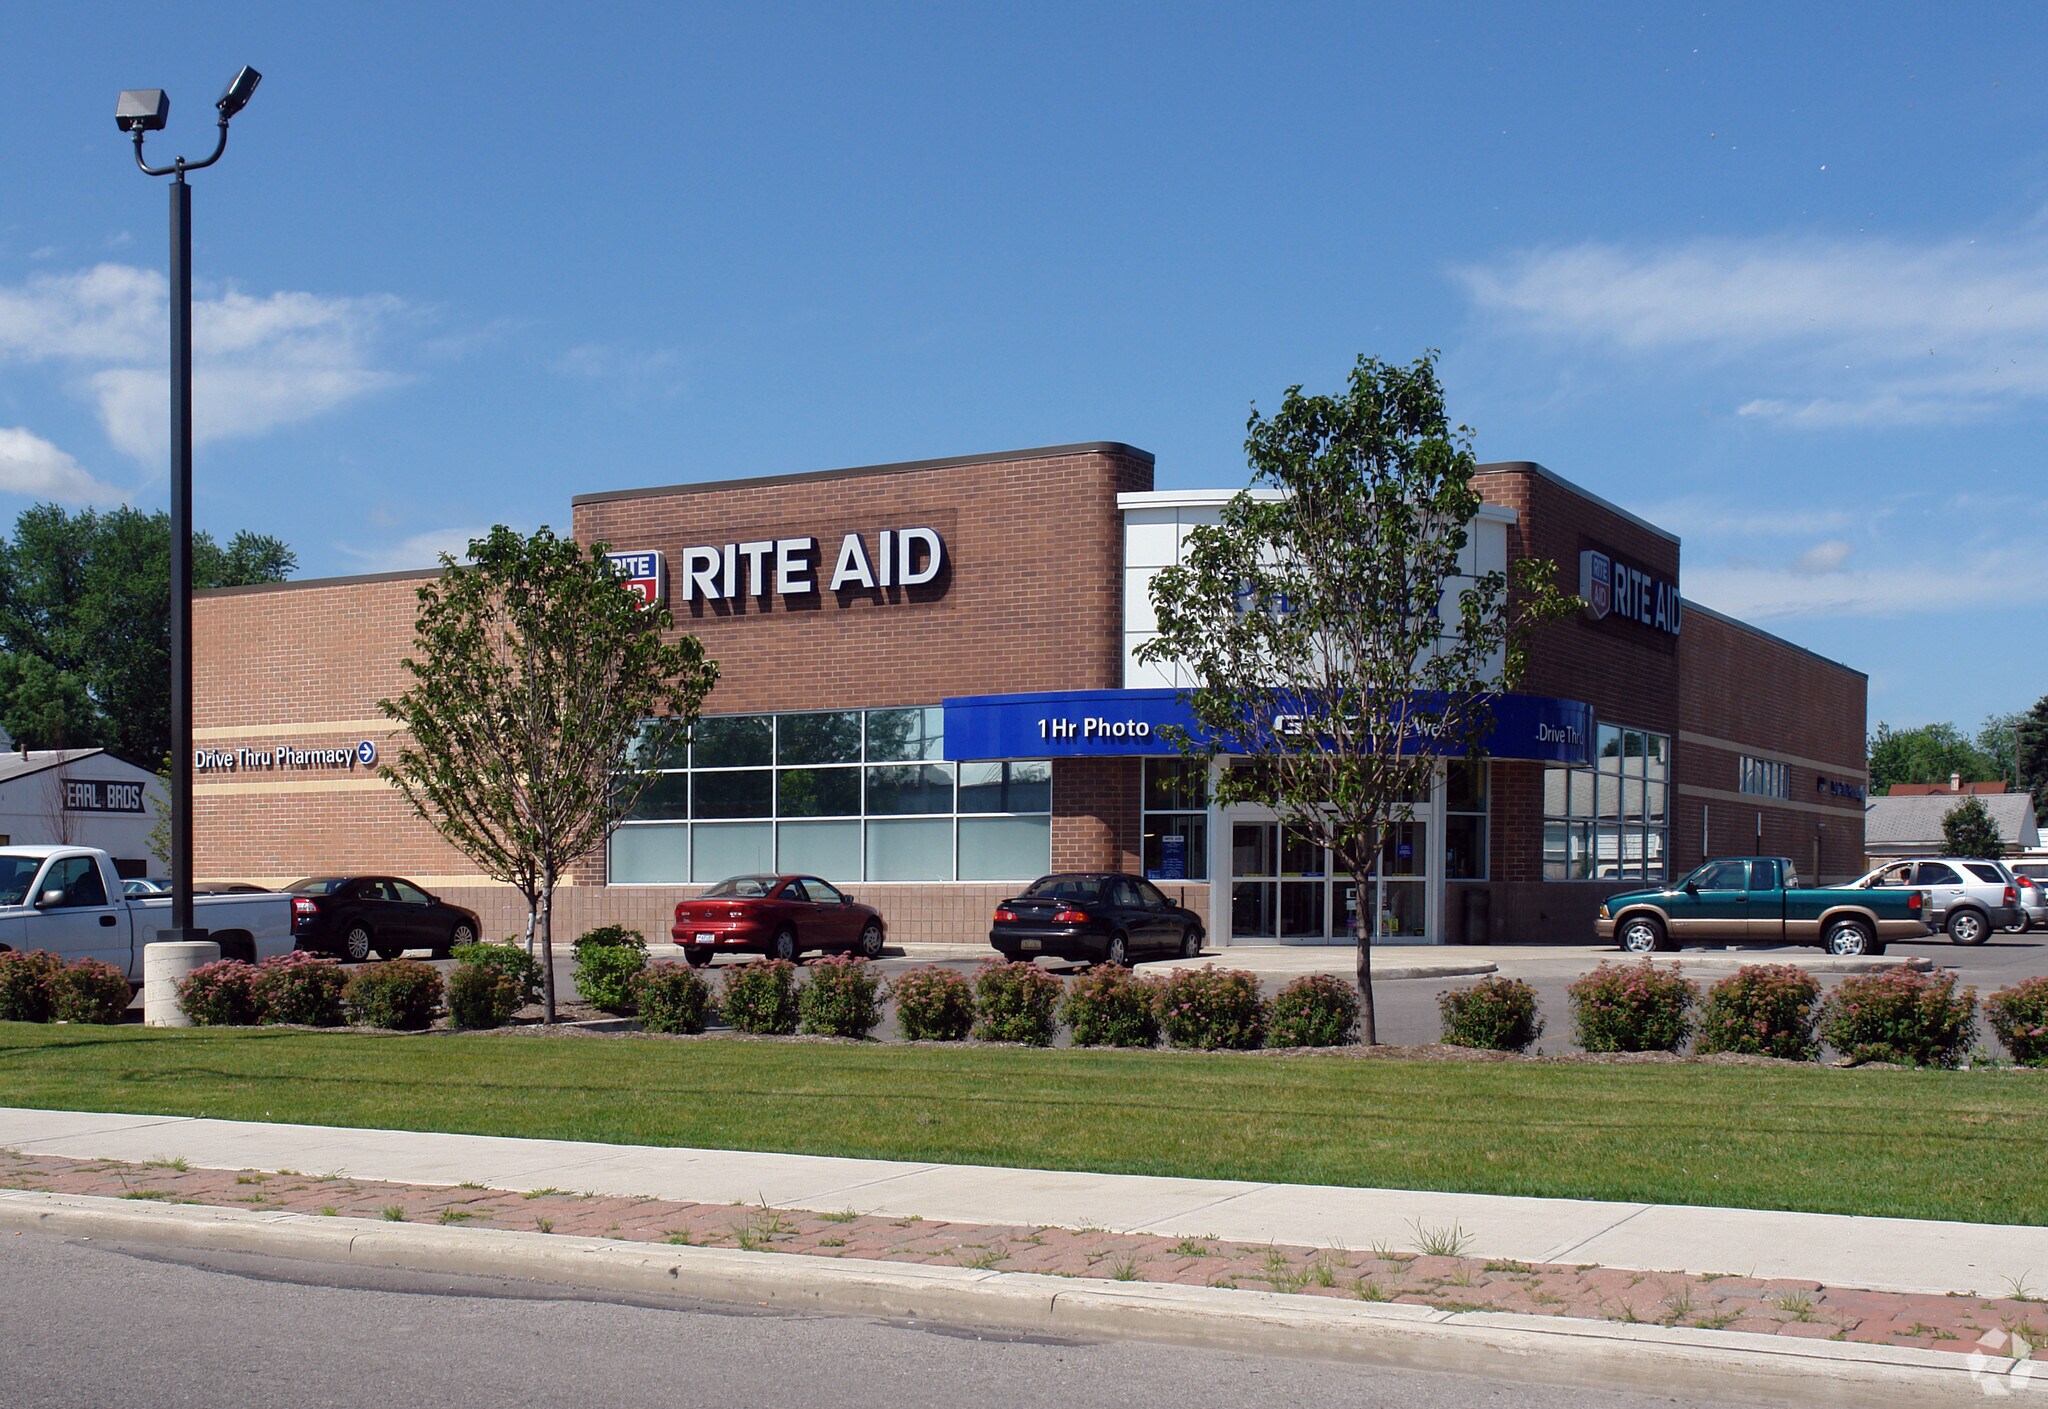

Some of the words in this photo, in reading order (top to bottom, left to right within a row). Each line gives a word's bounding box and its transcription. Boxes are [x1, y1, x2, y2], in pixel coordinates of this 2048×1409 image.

[682, 536, 815, 601] RITE
[829, 526, 944, 592] AID
[1593, 558, 1609, 581] RITE
[1594, 585, 1607, 607] AID
[1614, 562, 1651, 625] RITE
[1655, 581, 1682, 636] AID
[1083, 716, 1150, 738] Photo
[1539, 722, 1566, 744] Drive
[195, 749, 234, 768] Drive
[235, 748, 271, 766] Thru
[275, 745, 354, 767] Pharmacy
[66, 782, 102, 808] EARL
[106, 784, 140, 809] BROS
